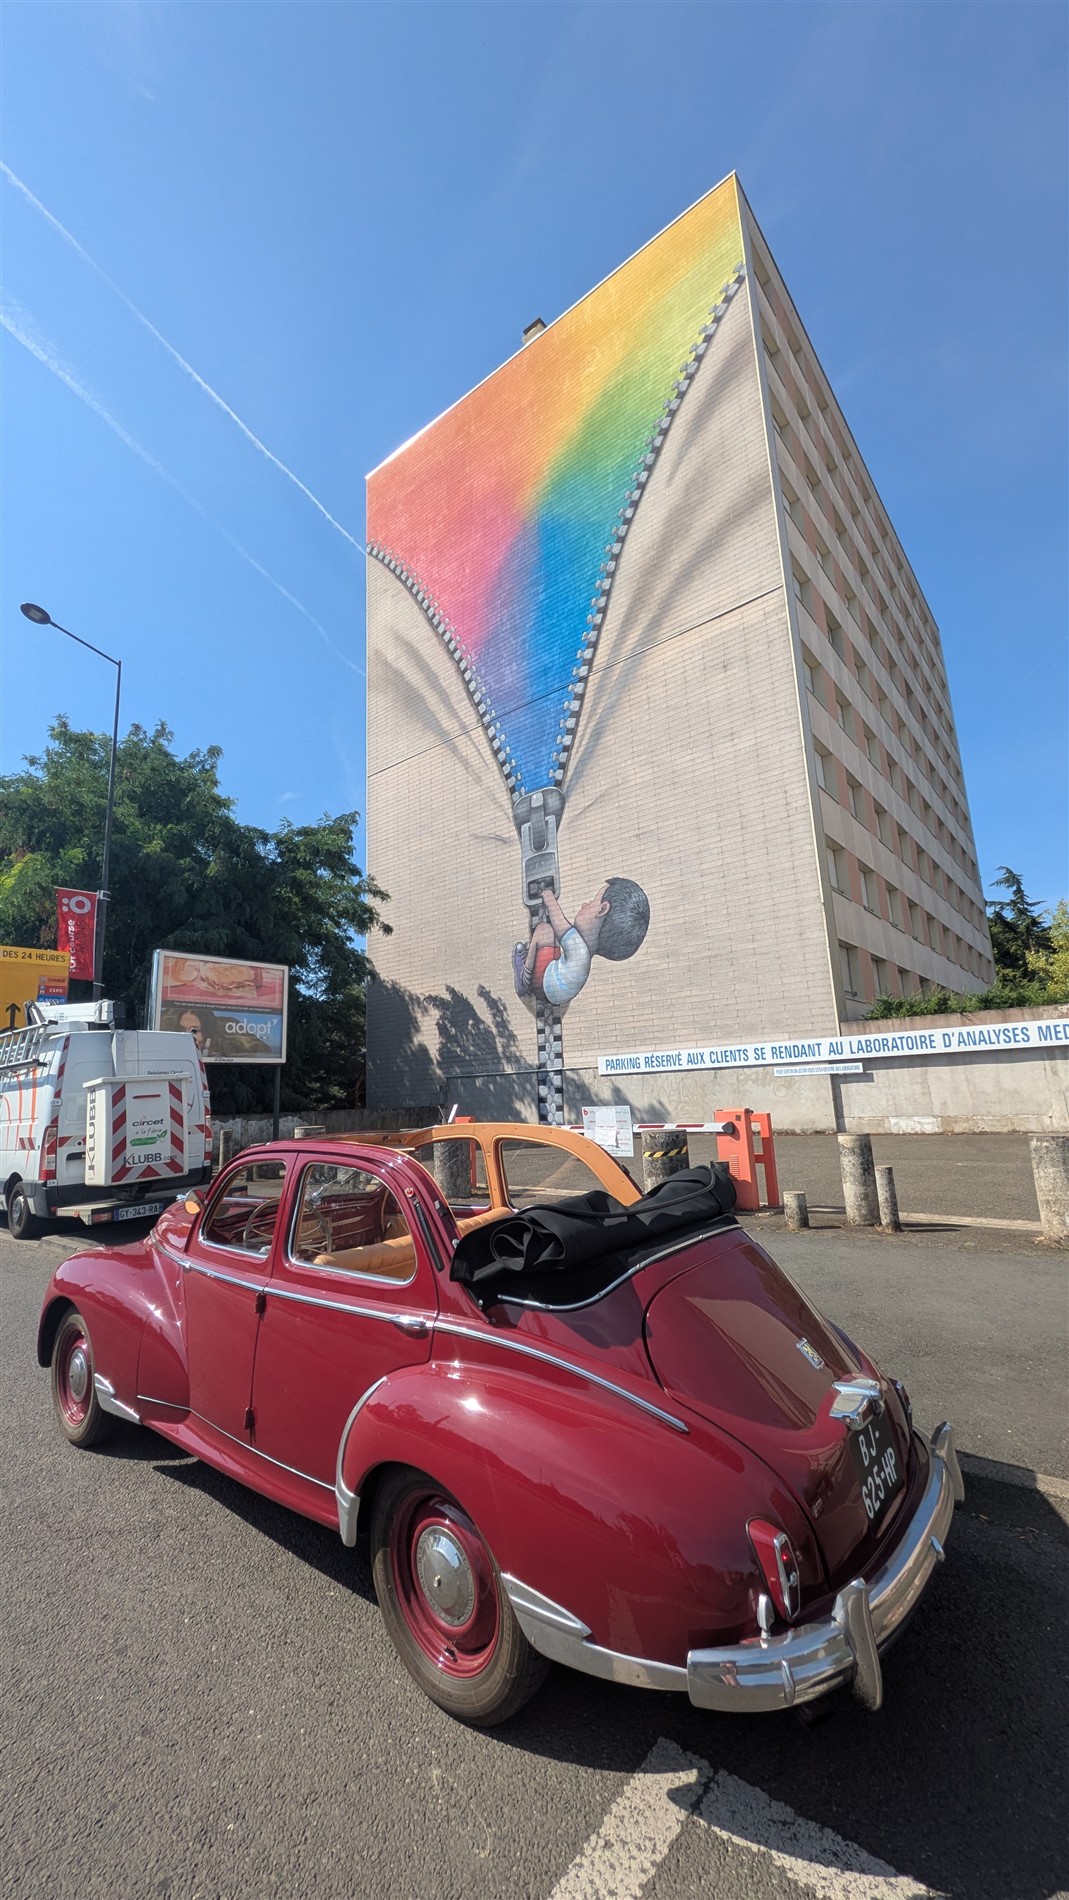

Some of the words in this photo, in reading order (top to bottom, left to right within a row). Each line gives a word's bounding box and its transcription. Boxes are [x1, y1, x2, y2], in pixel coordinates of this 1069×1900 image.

[2, 950, 19, 958] DES
[21, 952, 33, 960] 24
[35, 953, 66, 962] HEURES
[225, 1018, 272, 1038] adopt
[605, 1057, 641, 1071] PARKING
[644, 1051, 683, 1069] RÉSERVÉ
[686, 1052, 706, 1066] AUX
[709, 1048, 749, 1064] CLIENTS
[753, 1047, 767, 1061] SE
[771, 1043, 822, 1060] RENDANT
[828, 1041, 844, 1056] AU
[849, 1034, 936, 1055] LABORATOIRE
[942, 1027, 1030, 1048] D'ANALYSES
[86, 1087, 96, 1176] KLUBB
[132, 1118, 164, 1127] circet
[123, 1152, 177, 1166] KLUBB.com
[120, 1204, 158, 1219] GY-343-RA
[858, 1424, 880, 1468] BJ-
[862, 1447, 897, 1519] 625-HP
